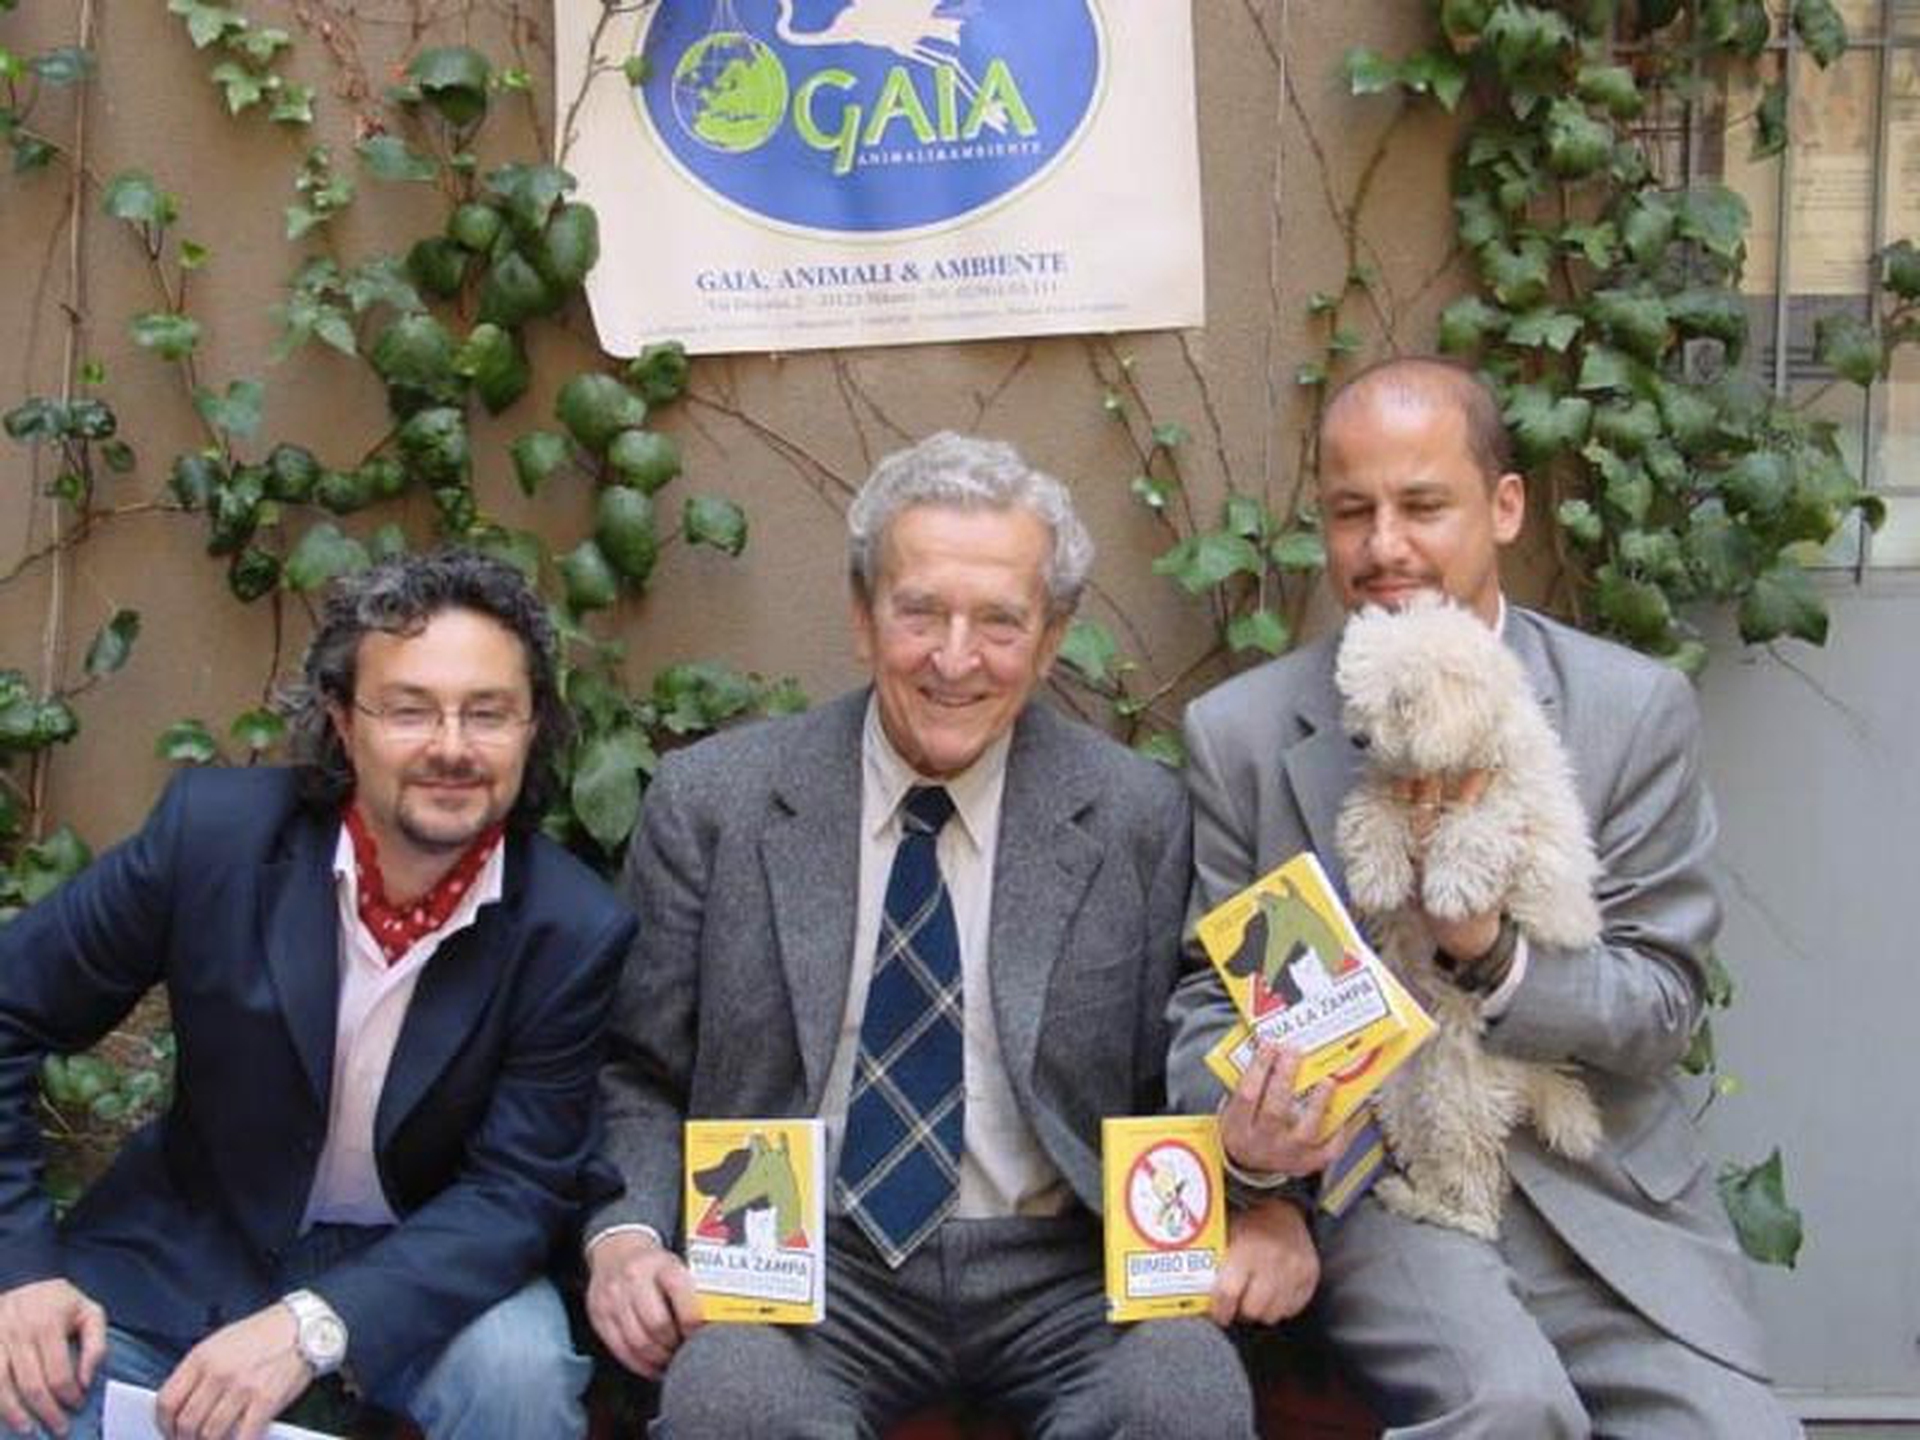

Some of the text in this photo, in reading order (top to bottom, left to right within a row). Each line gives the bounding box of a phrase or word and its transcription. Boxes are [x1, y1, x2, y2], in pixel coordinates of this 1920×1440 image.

[794, 57, 1038, 177] GAIA
[779, 262, 892, 289] ANIMALI
[901, 261, 919, 283] &
[931, 252, 1067, 279] AMBIENTE
[1294, 1006, 1317, 1028] LA
[1321, 978, 1374, 1015] ZAMPA
[727, 1252, 750, 1270] LA
[752, 1254, 807, 1277] ZAMPA
